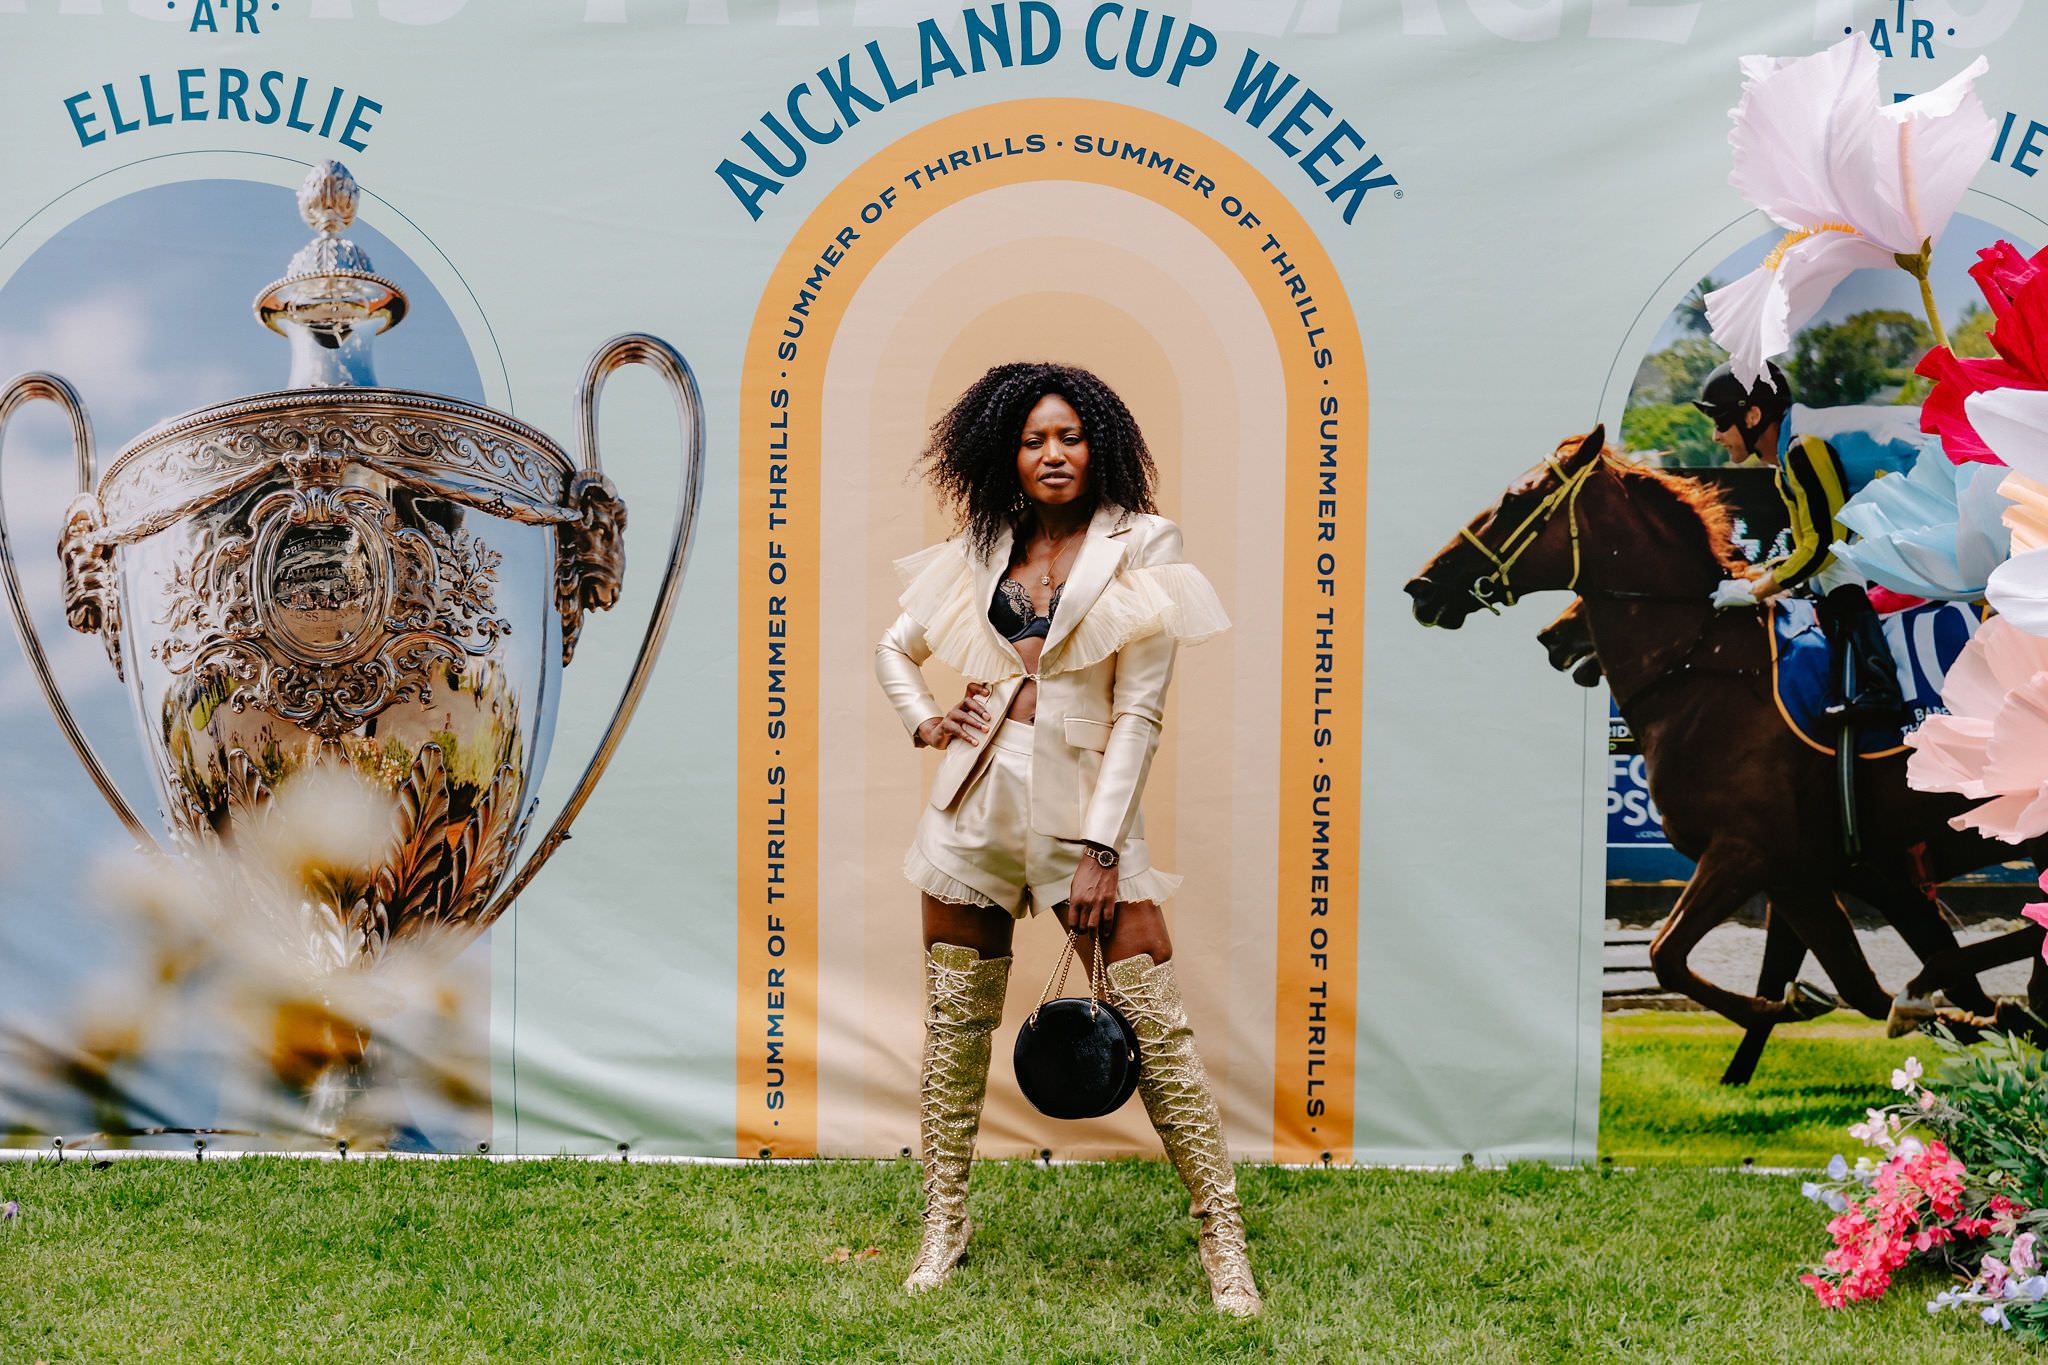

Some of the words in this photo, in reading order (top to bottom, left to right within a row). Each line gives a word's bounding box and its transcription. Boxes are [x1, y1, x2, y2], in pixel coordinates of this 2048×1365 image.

[64, 68, 382, 153] ELLERSLIE
[715, 1, 1061, 222] AUCKLAND
[1085, 3, 1217, 87] CUP
[778, 226, 860, 361] SUMMER
[861, 186, 897, 223] OF
[904, 134, 1046, 190] THRILLS
[1074, 135, 1215, 198] SUMMER
[1221, 196, 1261, 229] OF
[1261, 233, 1333, 369] THRILLS
[769, 388, 789, 530] THRILLS
[1317, 396, 1338, 542] SUMMER
[769, 541, 787, 585] OF
[1317, 553, 1335, 596] OF
[768, 595, 787, 739] SUMMER
[1313, 607, 1334, 747] THRILLS
[767, 765, 786, 904] THRILLS
[1310, 774, 1331, 917] SUMMER
[767, 914, 785, 957] OF
[1310, 927, 1328, 971] OF
[767, 968, 785, 1110] SUMMER
[1306, 981, 1327, 1117] THRILLS
